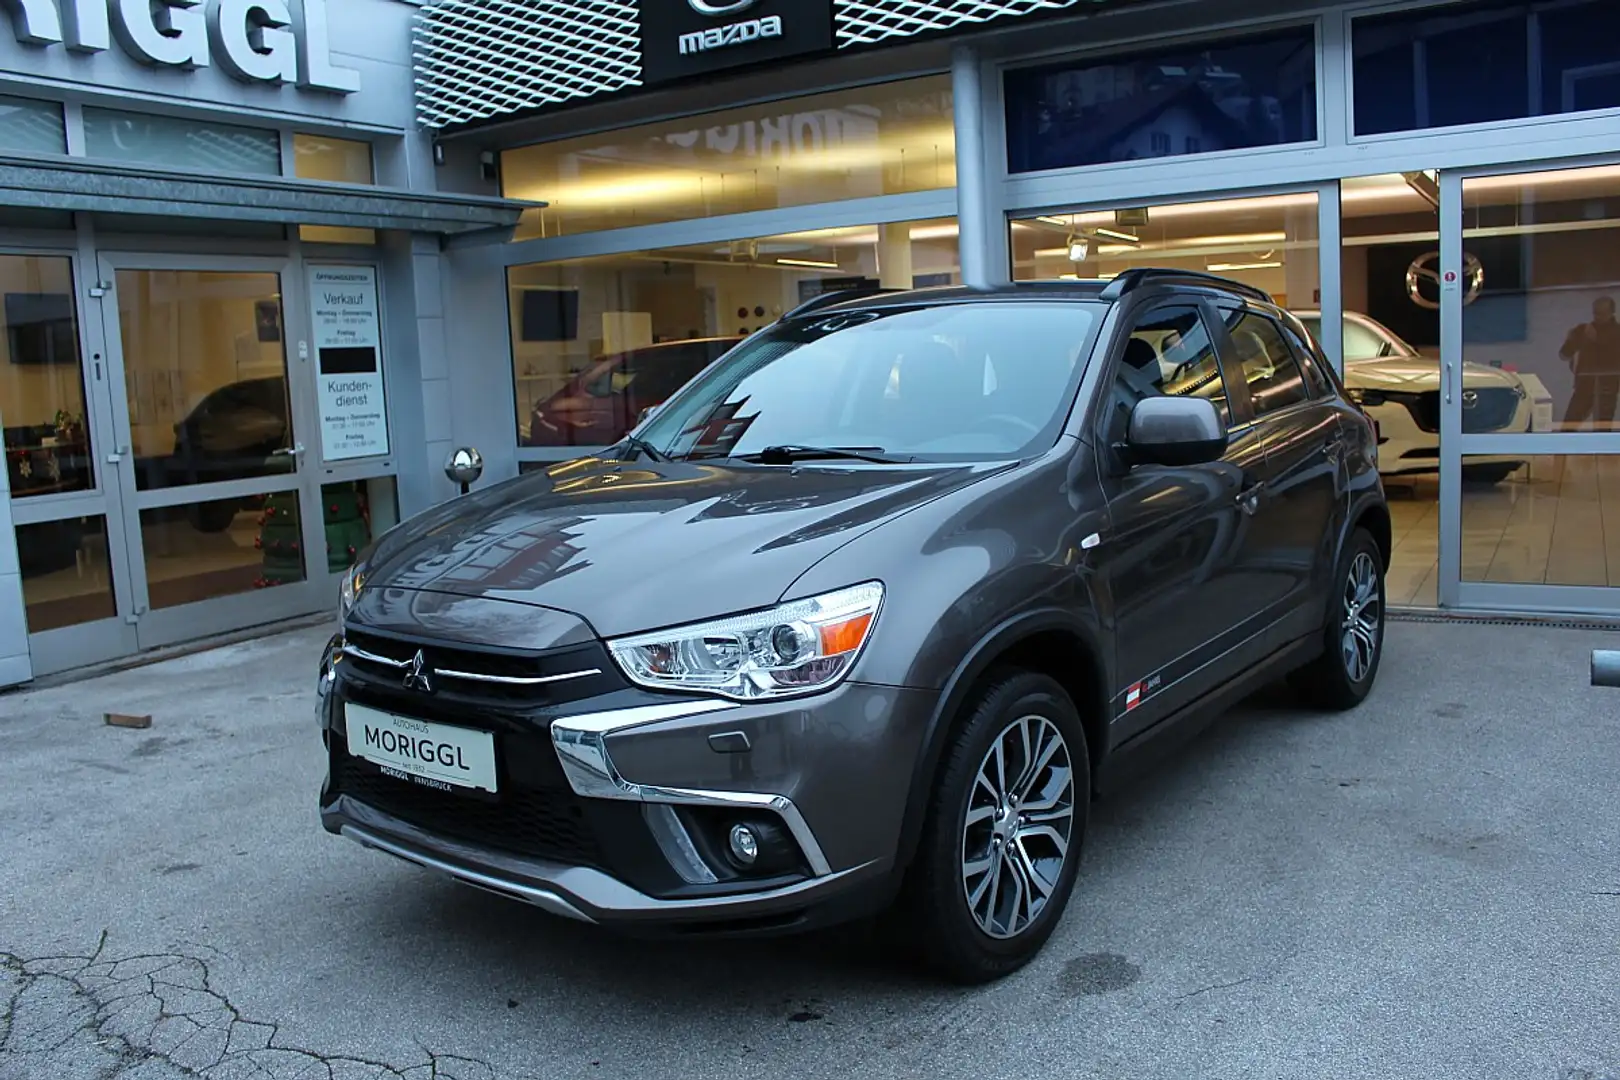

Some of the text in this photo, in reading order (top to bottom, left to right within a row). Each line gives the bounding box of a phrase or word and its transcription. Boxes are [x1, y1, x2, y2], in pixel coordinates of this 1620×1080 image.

[678, 15, 782, 54] mazda
[323, 293, 364, 305] Verkauf
[328, 380, 372, 393] Kunden-
[335, 394, 368, 407] dienst
[393, 718, 429, 734] AUTOHAUS
[364, 724, 470, 771] MORIGGL
[380, 765, 452, 792] MORIGGL INNSBRUCK
